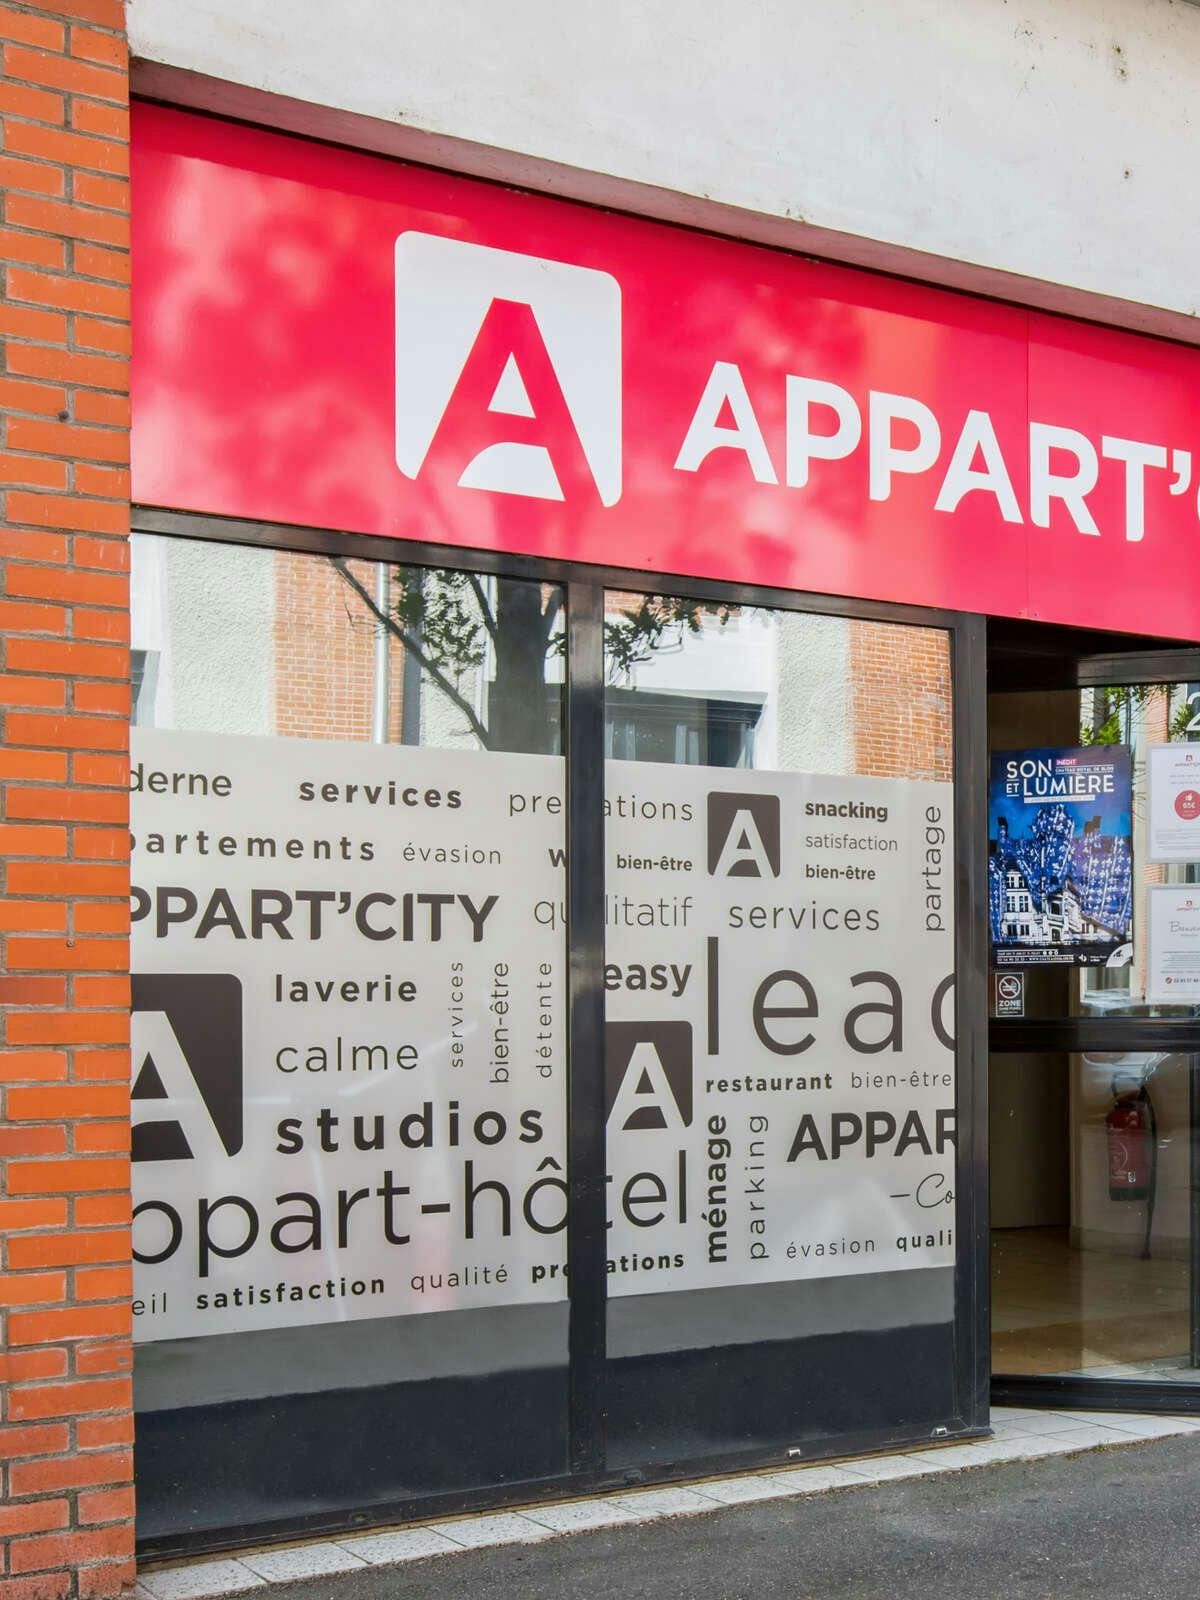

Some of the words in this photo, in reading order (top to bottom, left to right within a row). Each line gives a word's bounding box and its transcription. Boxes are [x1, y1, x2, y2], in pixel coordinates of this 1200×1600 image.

[1006, 759, 1052, 779] SON
[299, 780, 463, 809] services
[1006, 783, 1019, 794] ET
[805, 800, 889, 823] snacking
[402, 842, 502, 865] évasion
[805, 832, 898, 852] satisfaction
[616, 854, 693, 873] bien-être
[805, 864, 876, 882] bien-être
[922, 805, 946, 932] partage
[728, 901, 881, 931] services
[275, 974, 418, 1003] laverie
[604, 963, 693, 998] easy
[451, 962, 464, 1068] services
[998, 999, 1021, 1008] ZONE
[490, 962, 510, 1084] bien-être
[535, 963, 553, 1078] détente
[276, 1037, 419, 1073] calme
[705, 1073, 833, 1094] restaurant
[850, 1070, 952, 1090] bien-être
[275, 1101, 543, 1155] studios
[702, 1114, 733, 1263] ménage
[744, 1115, 769, 1260] parking
[786, 1238, 876, 1260] évasion
[196, 1276, 386, 1310] satisfaction
[410, 1264, 509, 1293] qualité
